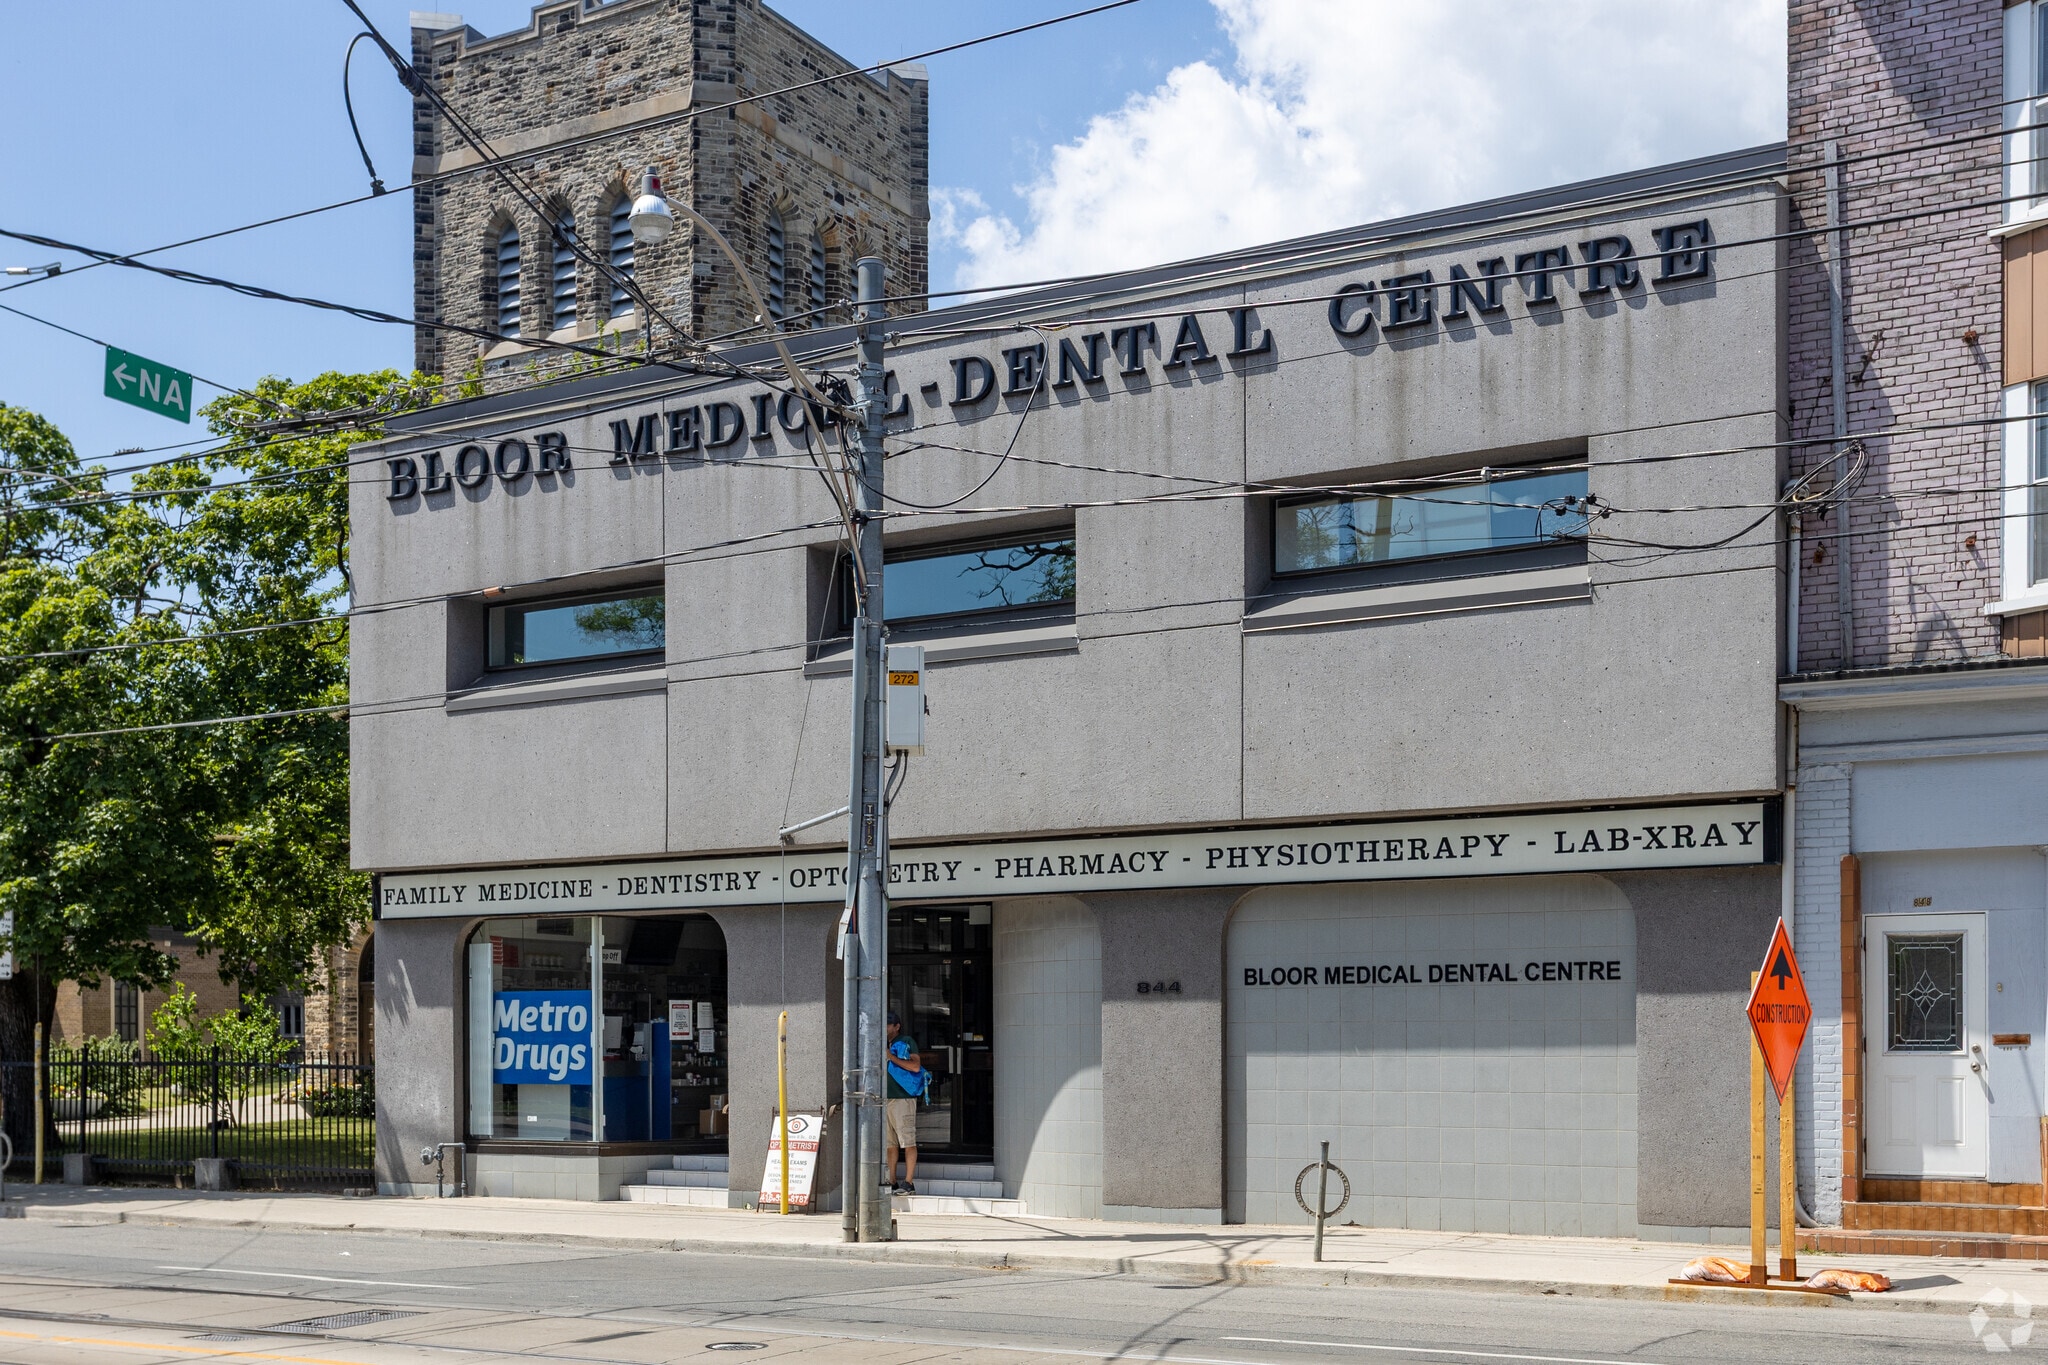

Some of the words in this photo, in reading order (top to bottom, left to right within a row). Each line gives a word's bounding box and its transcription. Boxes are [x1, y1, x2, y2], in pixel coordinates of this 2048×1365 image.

[386, 430, 571, 501] BLOOR
[1328, 218, 1711, 338] CENTRE
[139, 367, 185, 412] NA
[894, 674, 914, 684] 272
[383, 885, 467, 905] FAMILY
[478, 879, 592, 902] MEDICINE
[617, 871, 761, 896] DENTISTRY
[789, 860, 962, 888] OPTETRY
[995, 851, 1169, 879] PHARMACY
[1205, 834, 1510, 869] PHYSIOTHERAPY
[1554, 821, 1760, 854] LAB-XRAY
[1136, 981, 1181, 993] 844
[1243, 966, 1319, 986] BLOOR
[1323, 965, 1422, 985] MEDICAL
[1428, 963, 1518, 983] DENTAL
[1524, 961, 1621, 982] CENTRE
[494, 999, 588, 1032] Metro
[1756, 1003, 1806, 1024] CONSTRUCTION
[494, 1036, 587, 1081] Drugs
[770, 1140, 817, 1150] OPTMETRIST
